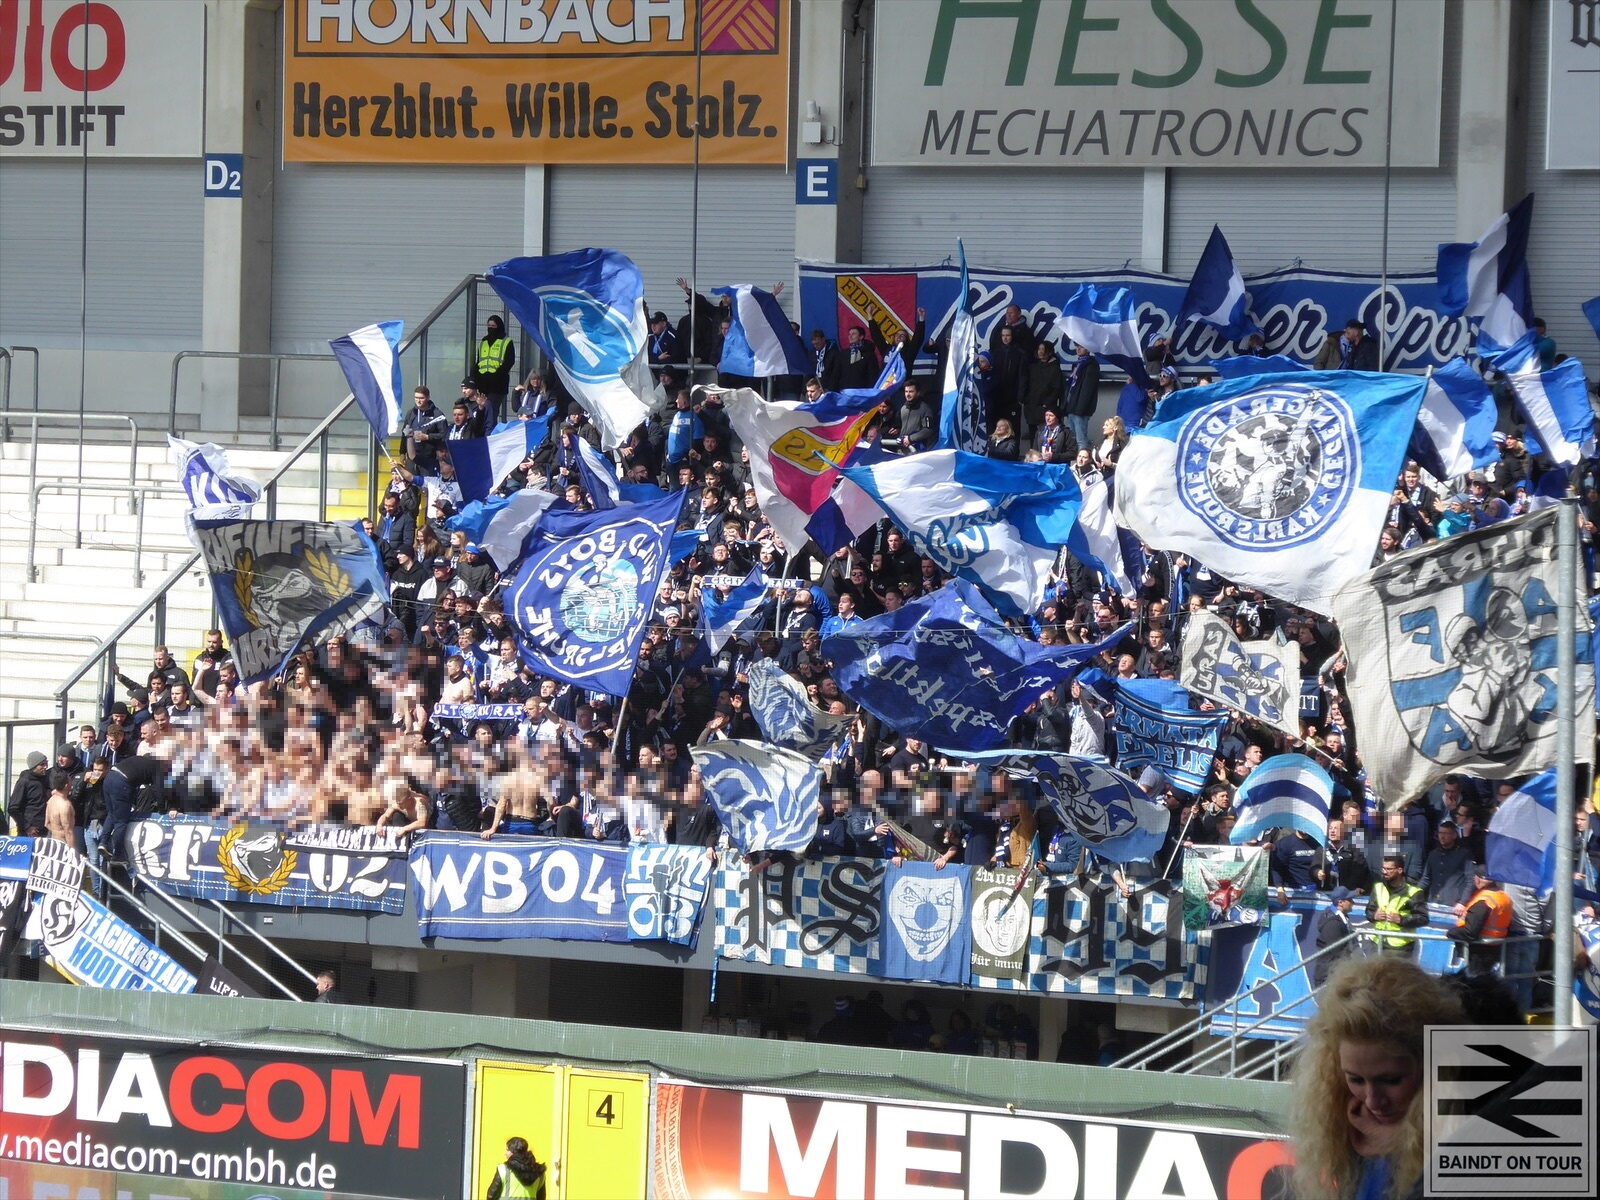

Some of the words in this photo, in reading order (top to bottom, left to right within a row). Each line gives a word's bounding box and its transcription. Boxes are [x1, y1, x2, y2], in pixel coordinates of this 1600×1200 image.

[304, 0, 684, 44] HORNBACH
[923, 0, 1372, 87] HESSE
[293, 81, 496, 139] Herzblut.
[505, 81, 633, 139] Wille.
[645, 80, 778, 139] Stolz.
[920, 109, 1366, 156] MECHATRONICS
[806, 165, 829, 196] E
[596, 1094, 616, 1125] 4
